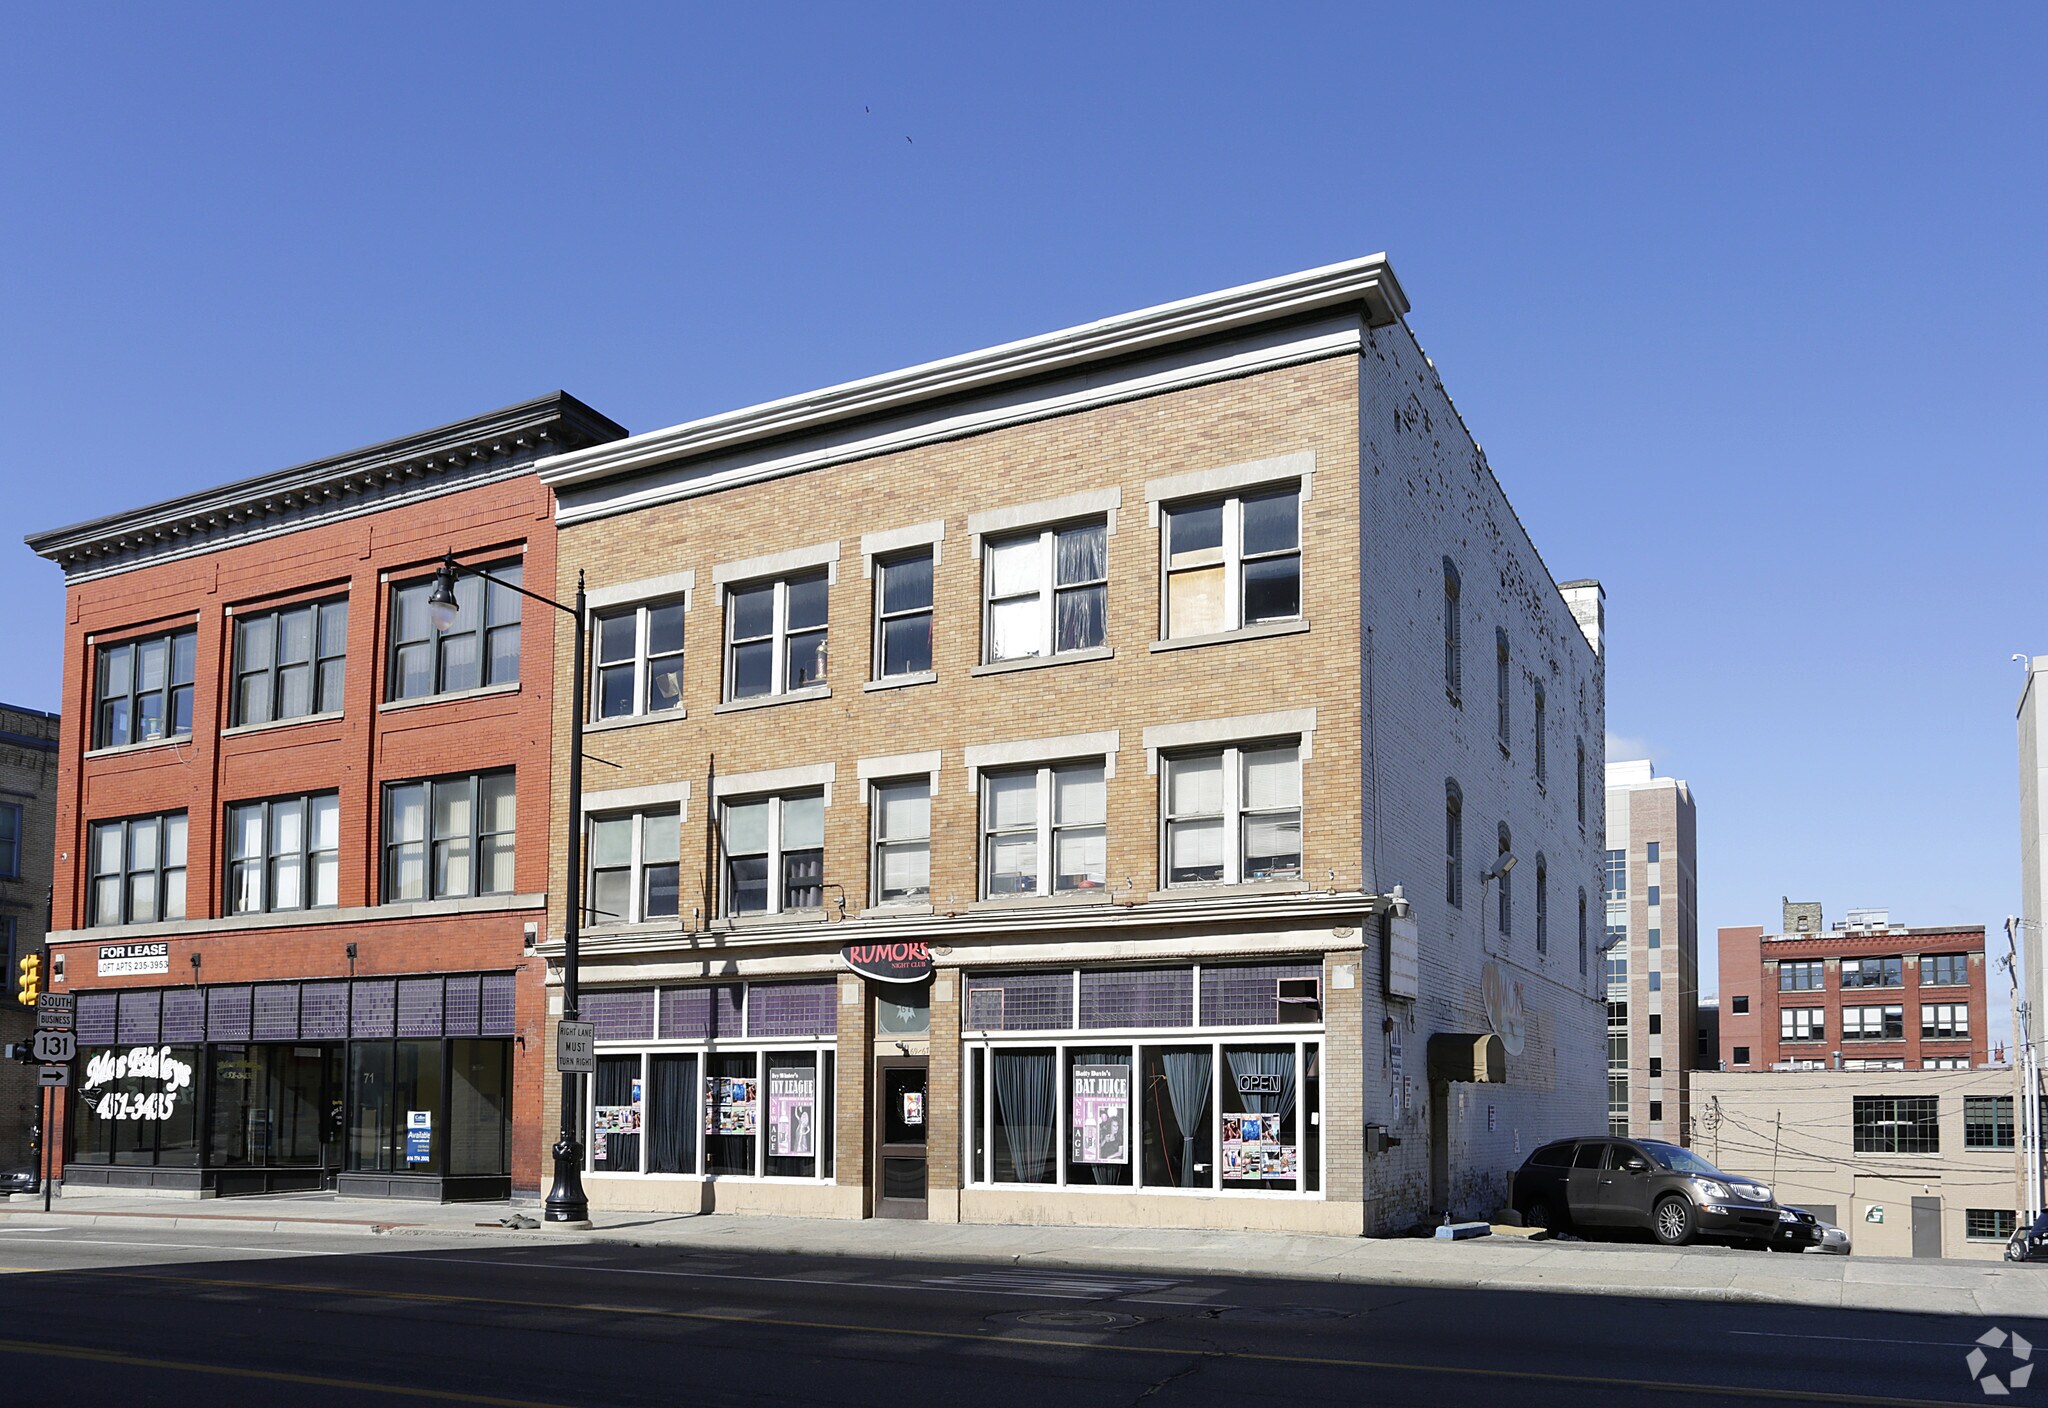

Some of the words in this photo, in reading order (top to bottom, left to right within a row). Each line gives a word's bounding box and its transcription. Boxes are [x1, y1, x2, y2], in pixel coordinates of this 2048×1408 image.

[100, 946, 125, 959] FOR
[127, 944, 167, 957] LEASE
[849, 942, 929, 964] RUMORS
[99, 963, 114, 973] LOFT
[116, 962, 133, 971] APTS
[134, 960, 168, 970] 235-3953
[41, 995, 72, 1008] SOUTH
[41, 1015, 70, 1025] BUSINESS
[560, 1027, 576, 1036] RIGHT
[578, 1029, 592, 1037] LANE
[42, 1036, 68, 1056] 131
[566, 1042, 585, 1052] MUST
[560, 1057, 574, 1065] TURN
[576, 1057, 592, 1066] RIGHT
[363, 1073, 374, 1084] 71
[1241, 1076, 1279, 1091] OPEN
[771, 1080, 784, 1094] IVY
[784, 1080, 814, 1094] LEAGUE
[1075, 1078, 1095, 1094] BAT
[1097, 1078, 1127, 1094] JUICE
